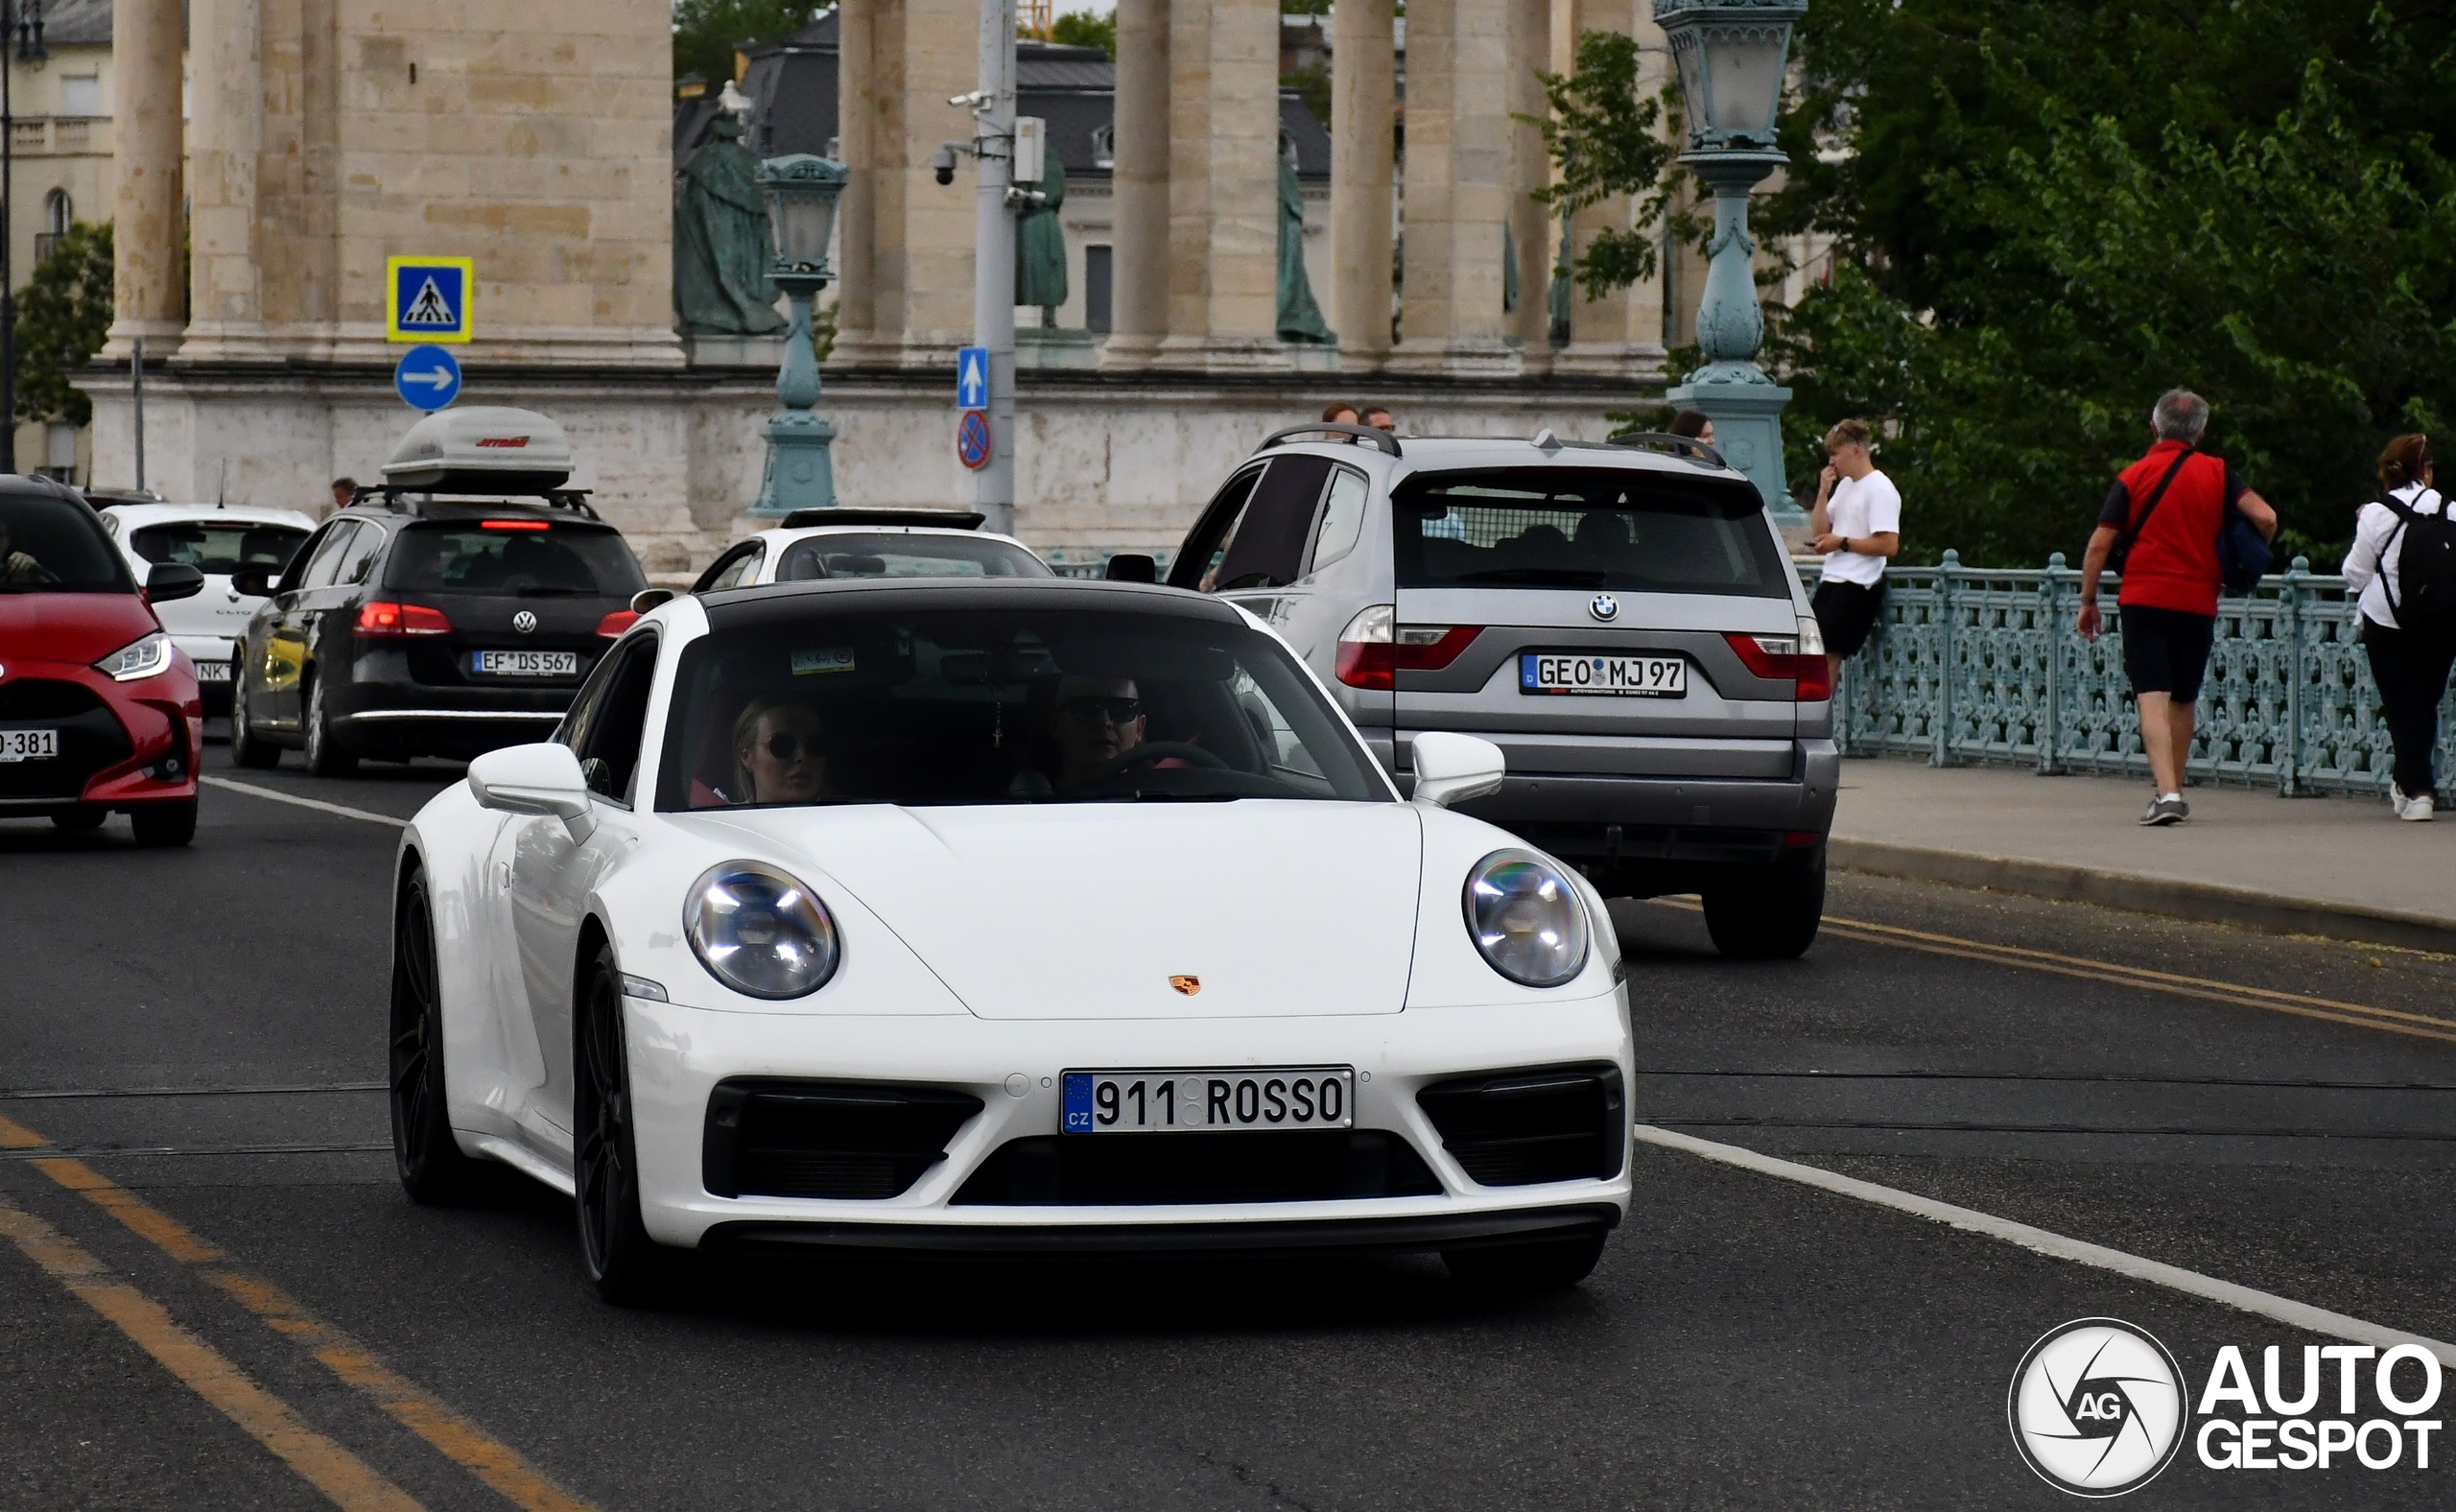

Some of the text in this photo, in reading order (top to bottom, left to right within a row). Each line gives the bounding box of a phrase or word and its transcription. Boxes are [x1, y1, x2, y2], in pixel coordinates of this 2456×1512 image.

[201, 664, 230, 678] NK
[484, 653, 506, 670] EF
[519, 653, 539, 670] DS
[543, 653, 574, 671] 567
[1539, 658, 1681, 688] GEO MJ 97
[1096, 1077, 1343, 1125] 911 ROSSO
[1068, 1112, 1089, 1125] CZ
